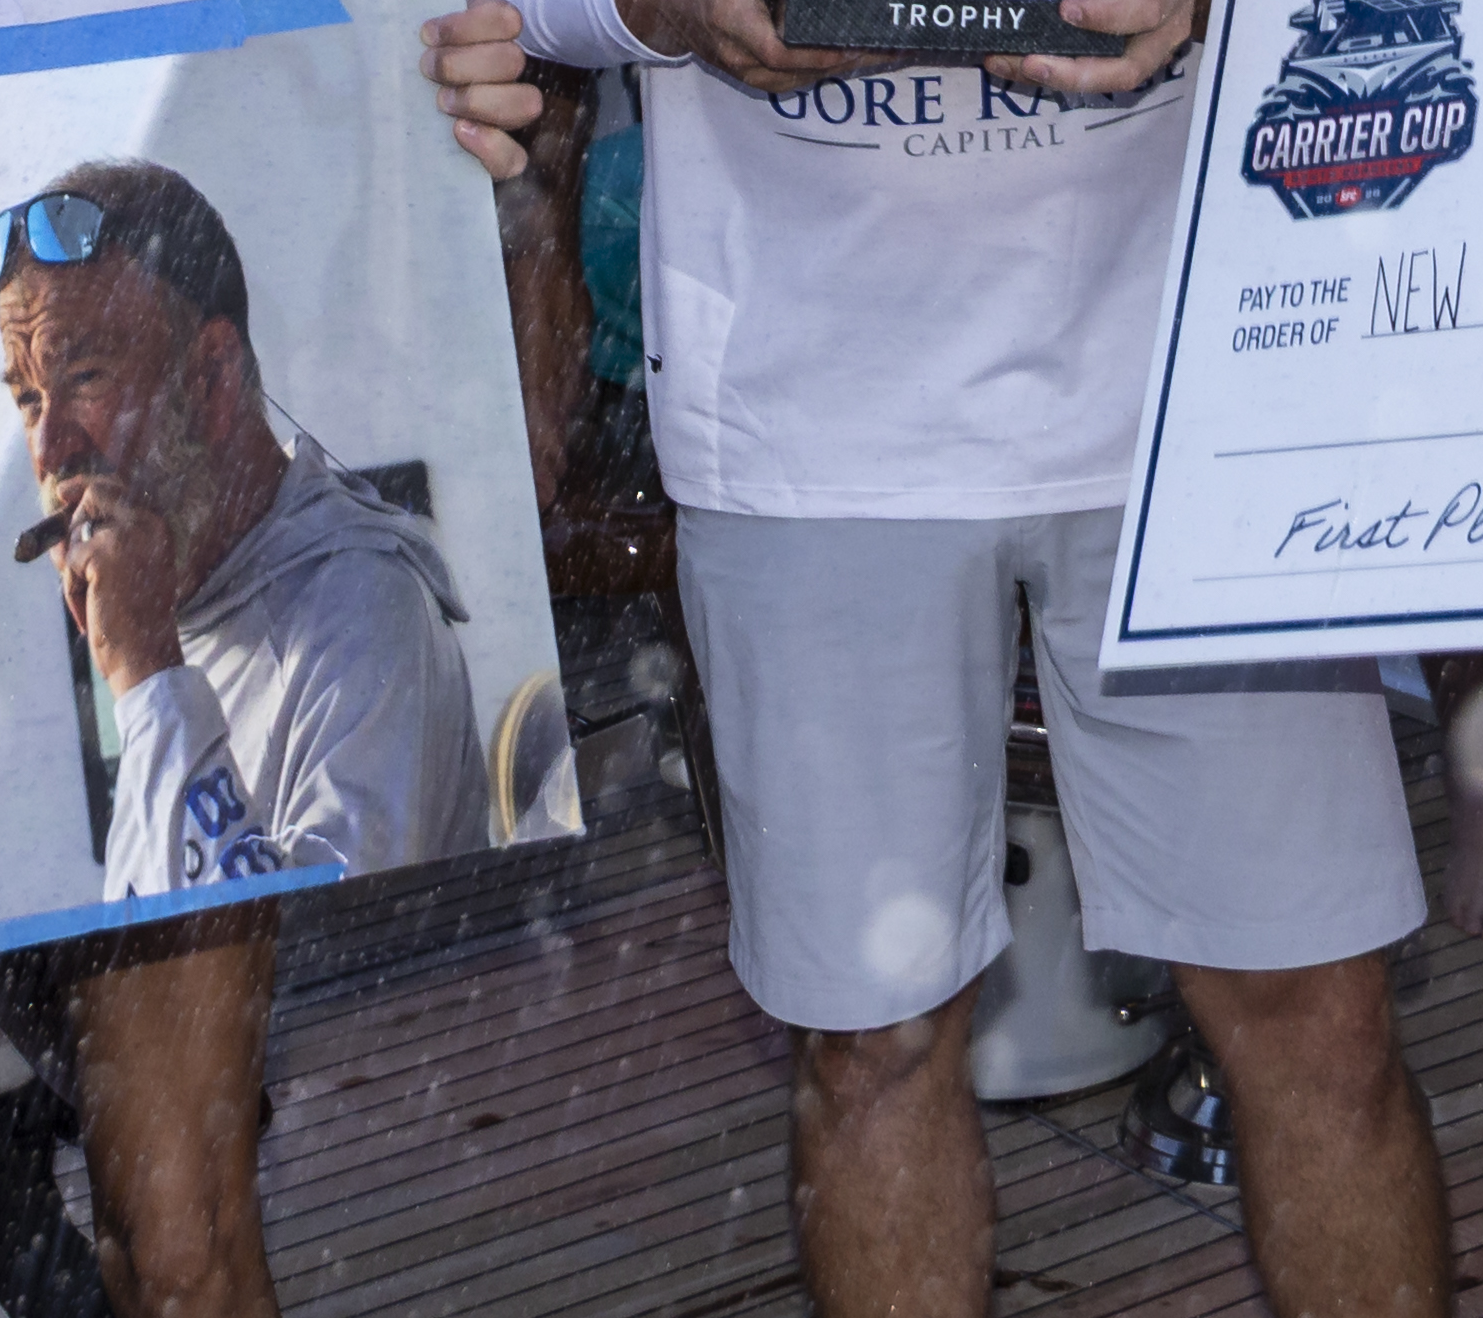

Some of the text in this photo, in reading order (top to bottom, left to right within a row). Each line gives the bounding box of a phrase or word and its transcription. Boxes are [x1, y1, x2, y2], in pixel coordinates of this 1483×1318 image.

[889, 3, 1025, 30] TROPHY
[903, 123, 1065, 157] CAPITAL
[1252, 100, 1467, 171] CARRIER CUP
[1239, 277, 1350, 313] PAY TO THE
[1371, 242, 1469, 335] NEW
[1232, 317, 1339, 352] ORDER OF
[1274, 498, 1427, 559] First
